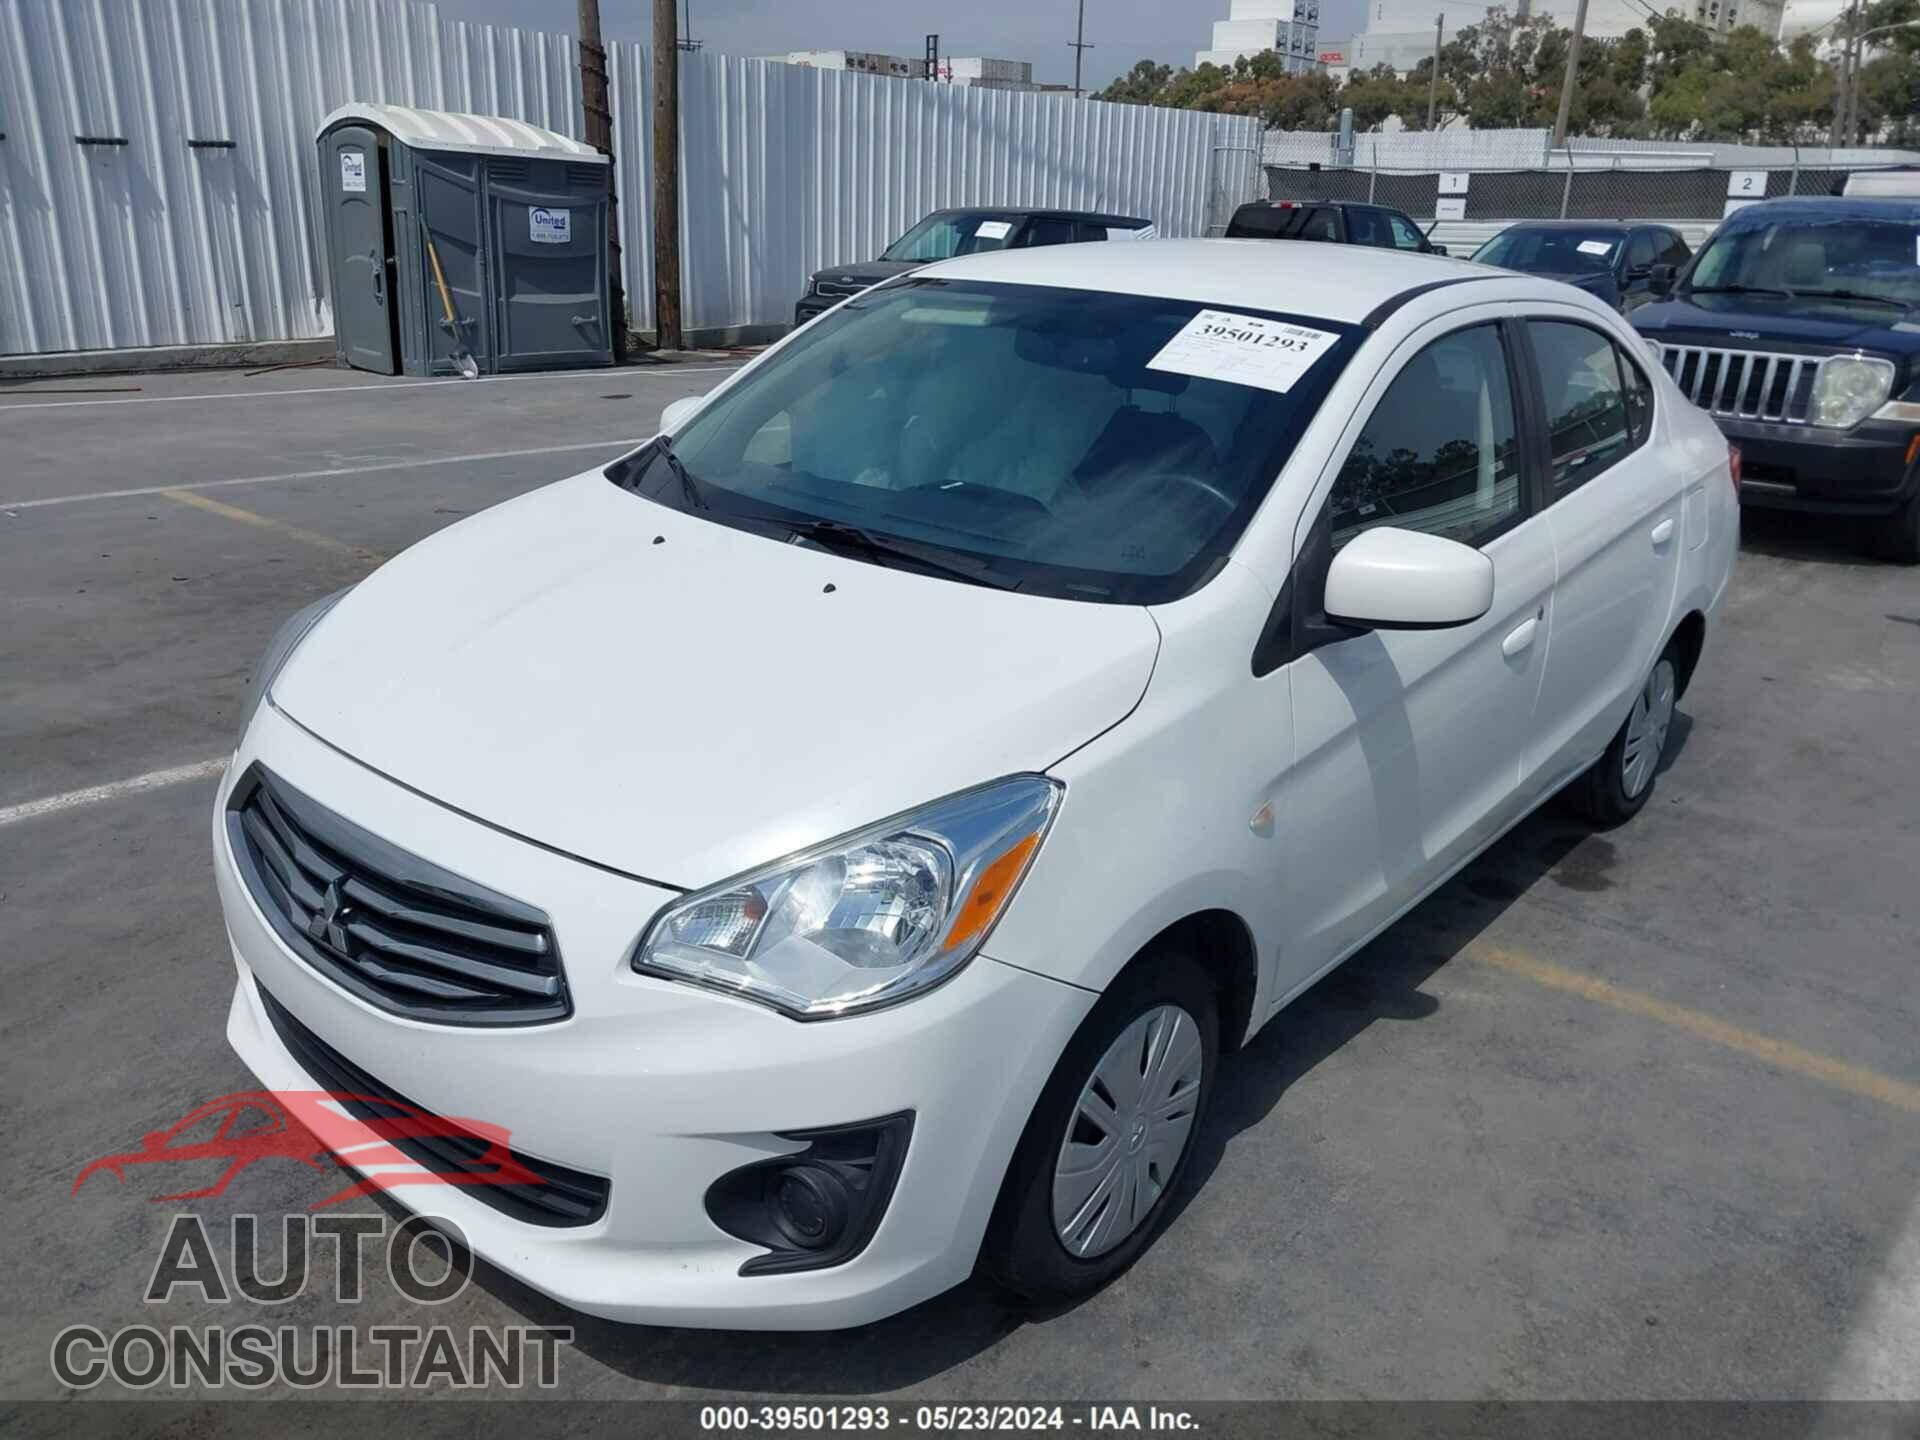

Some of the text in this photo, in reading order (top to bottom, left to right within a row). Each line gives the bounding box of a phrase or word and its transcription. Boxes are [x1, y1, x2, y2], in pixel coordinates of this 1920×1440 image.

[1742, 177, 1753, 191] 2
[535, 213, 566, 226] United
[1195, 323, 1309, 352] 39501293
